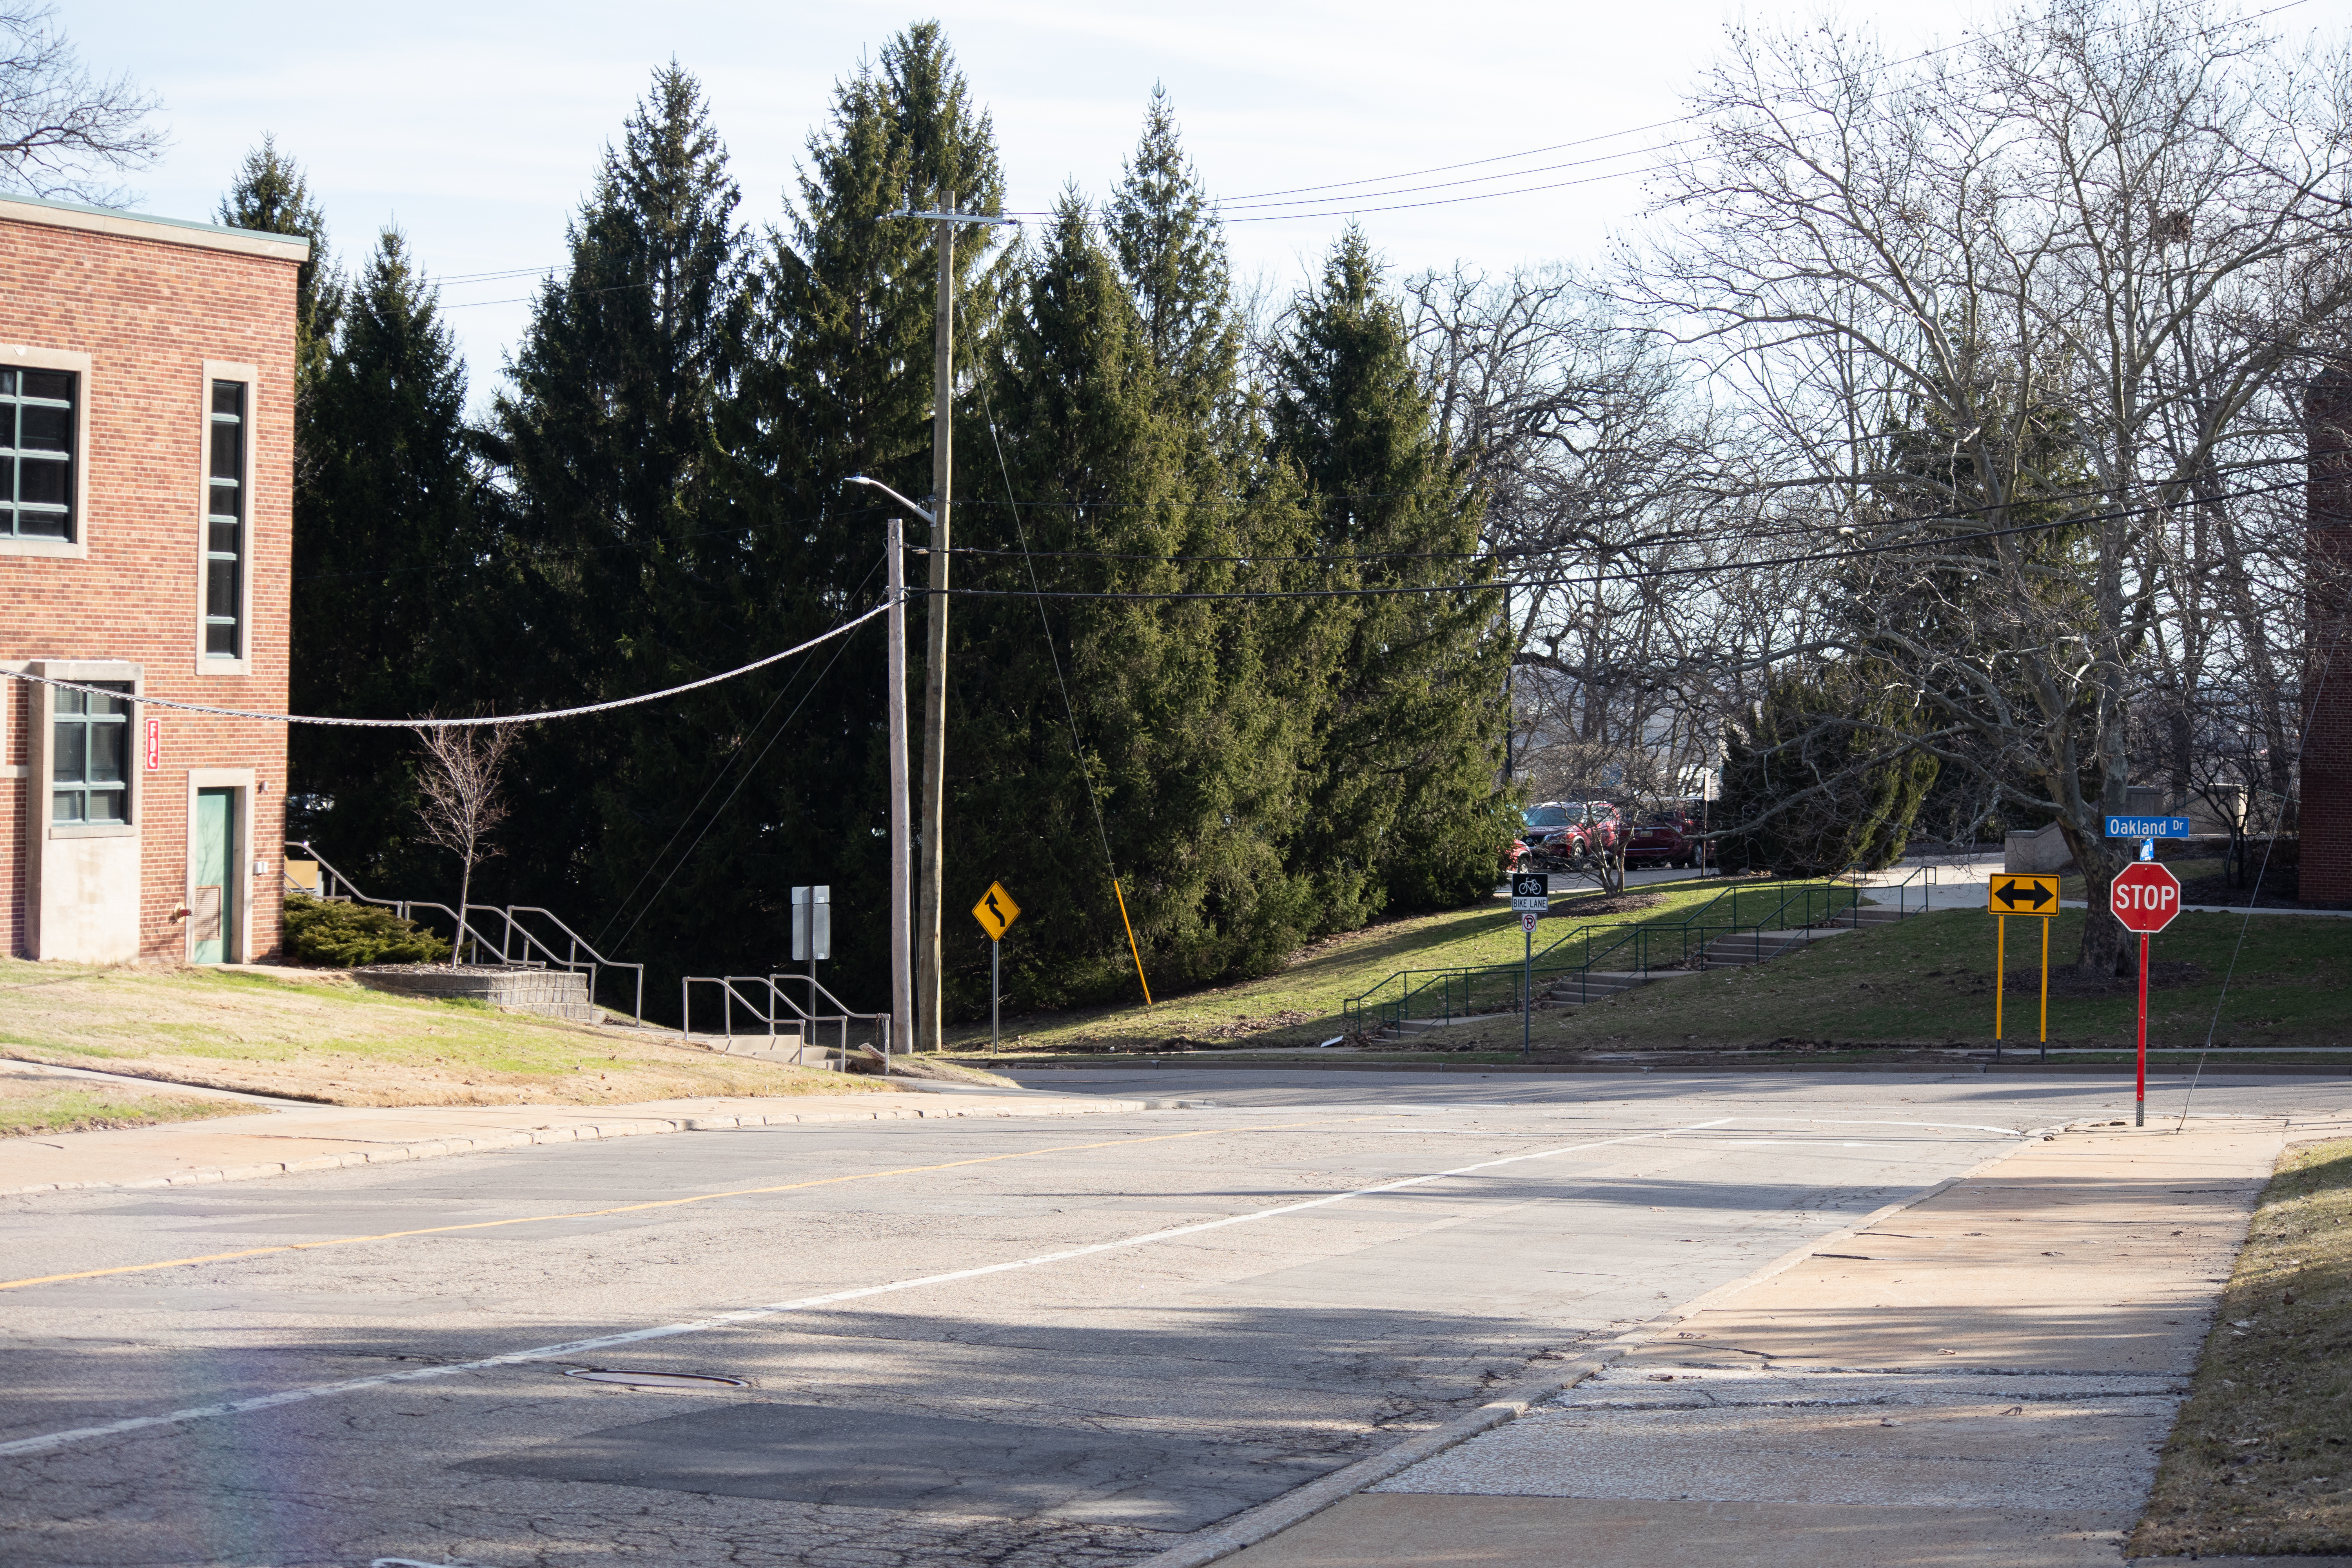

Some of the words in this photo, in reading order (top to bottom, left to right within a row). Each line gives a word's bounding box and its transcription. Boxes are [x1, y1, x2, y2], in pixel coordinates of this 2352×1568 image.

[2110, 819, 2166, 835] Oakland
[2173, 820, 2184, 830] Dr
[1514, 899, 1527, 908] BIKE
[1530, 899, 1546, 908] LANE
[2116, 884, 2175, 910] STOP
[867, 1047, 884, 1060] STEPS
